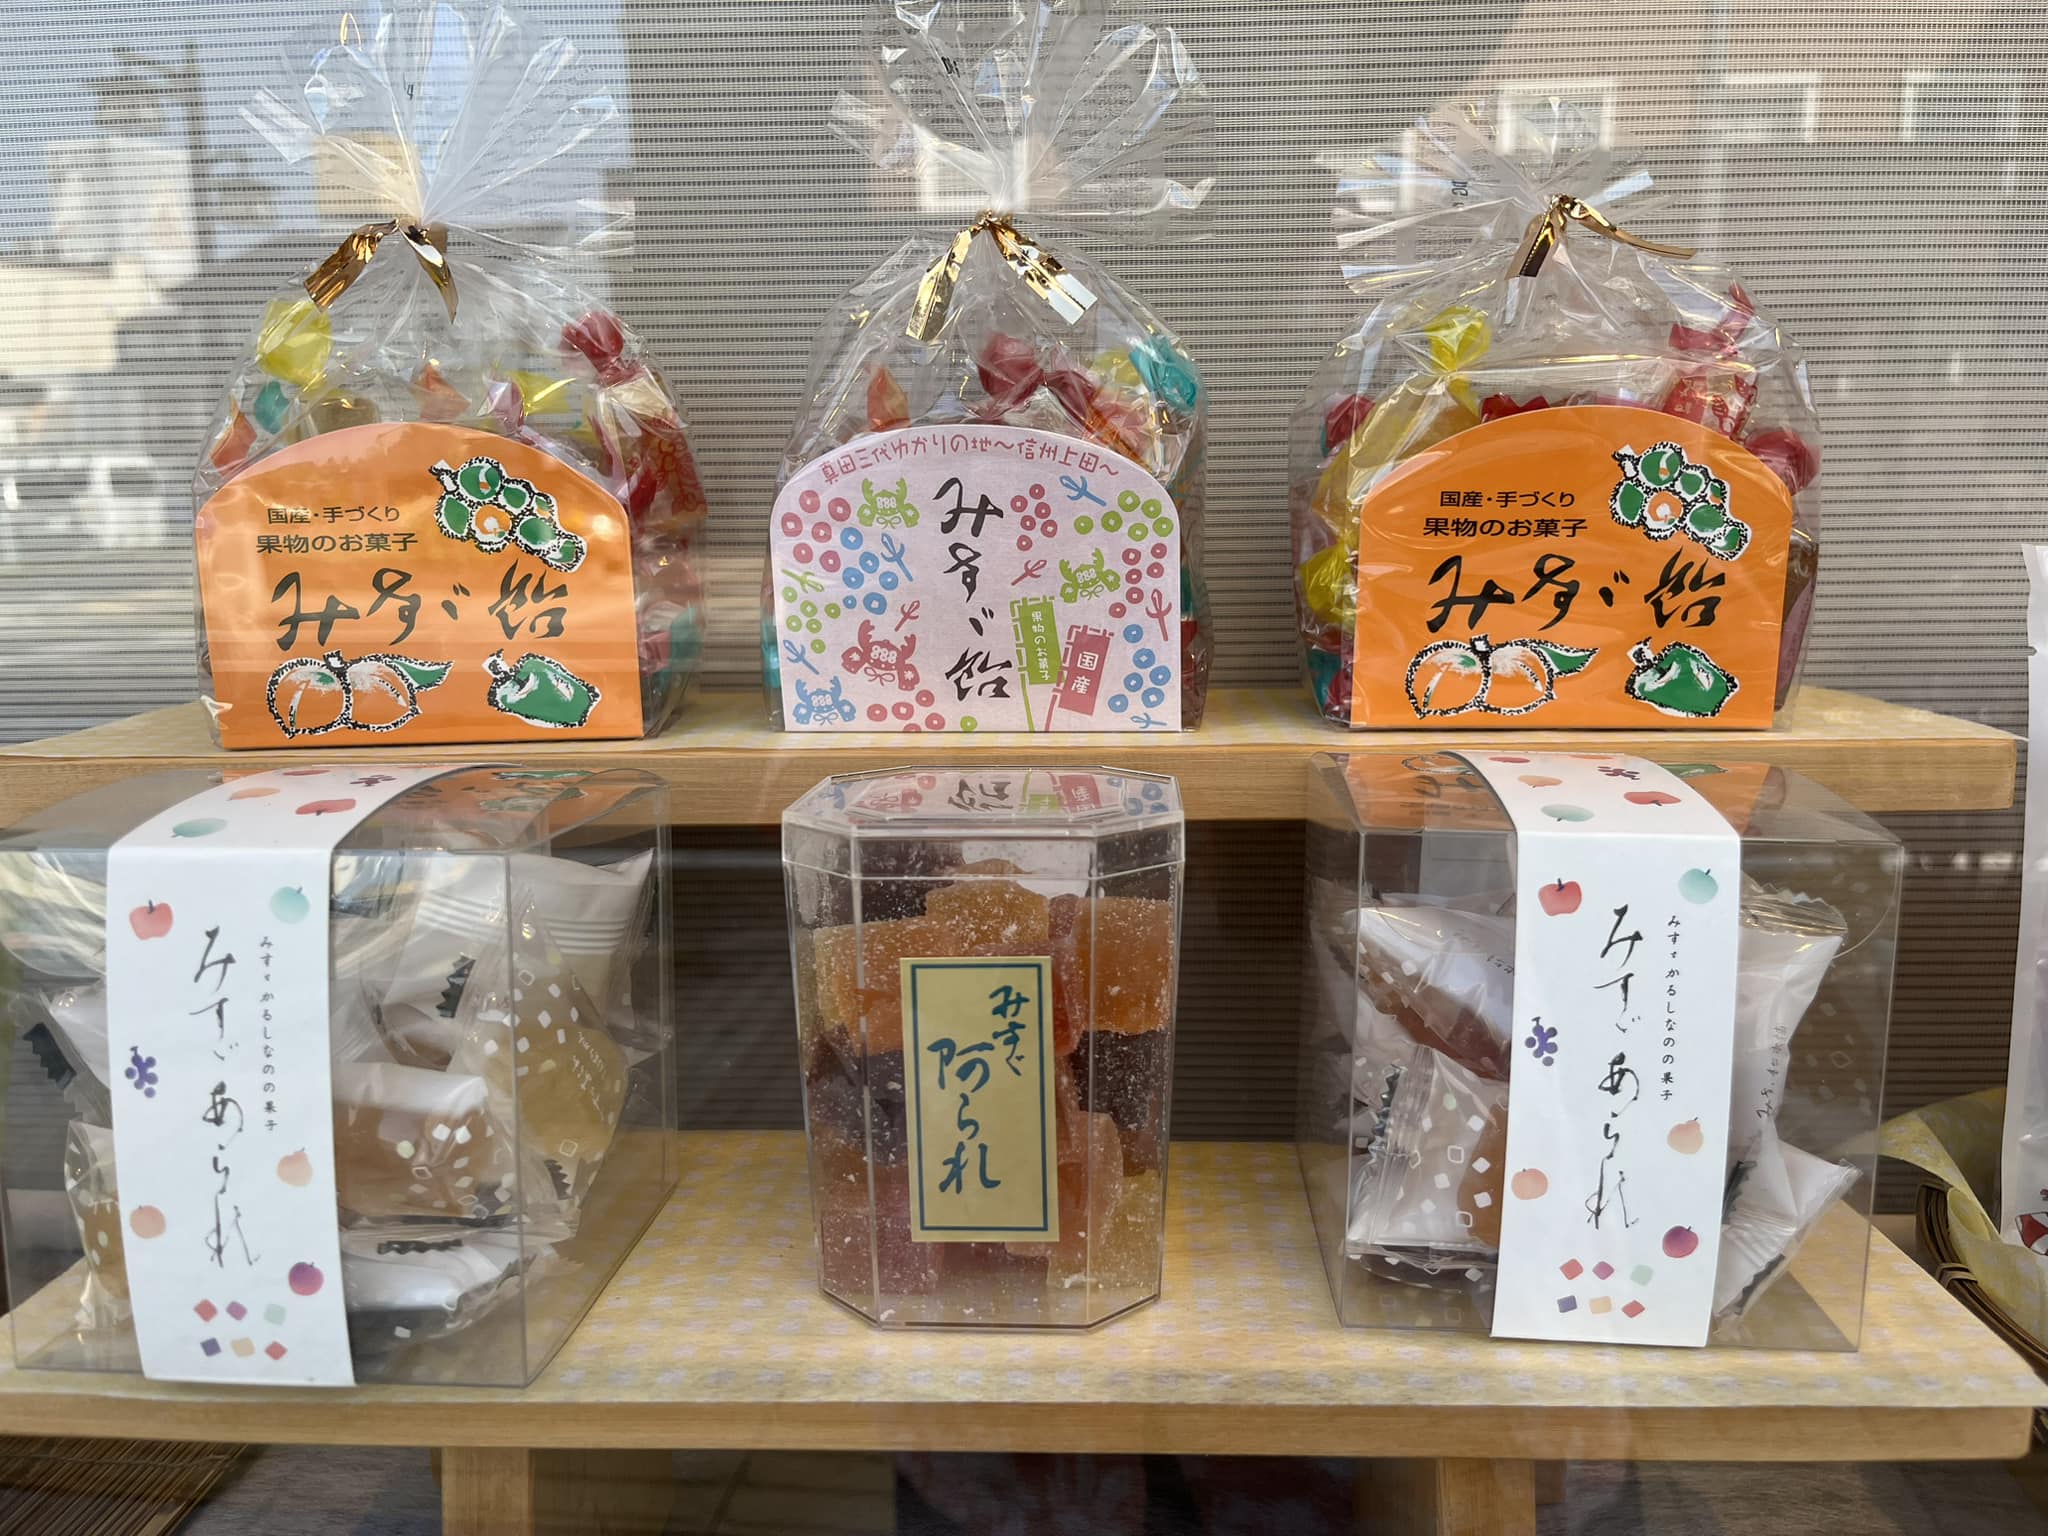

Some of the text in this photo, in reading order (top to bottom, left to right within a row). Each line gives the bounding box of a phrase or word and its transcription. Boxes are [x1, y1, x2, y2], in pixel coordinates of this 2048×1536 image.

[1440, 491, 1576, 508] 国産・手づくり
[1423, 518, 1588, 538] 果物のお菓子
[256, 533, 418, 555] 果物のお菓子
[1032, 610, 1050, 681] 果物のお菓子
[1071, 651, 1099, 694] 国産
